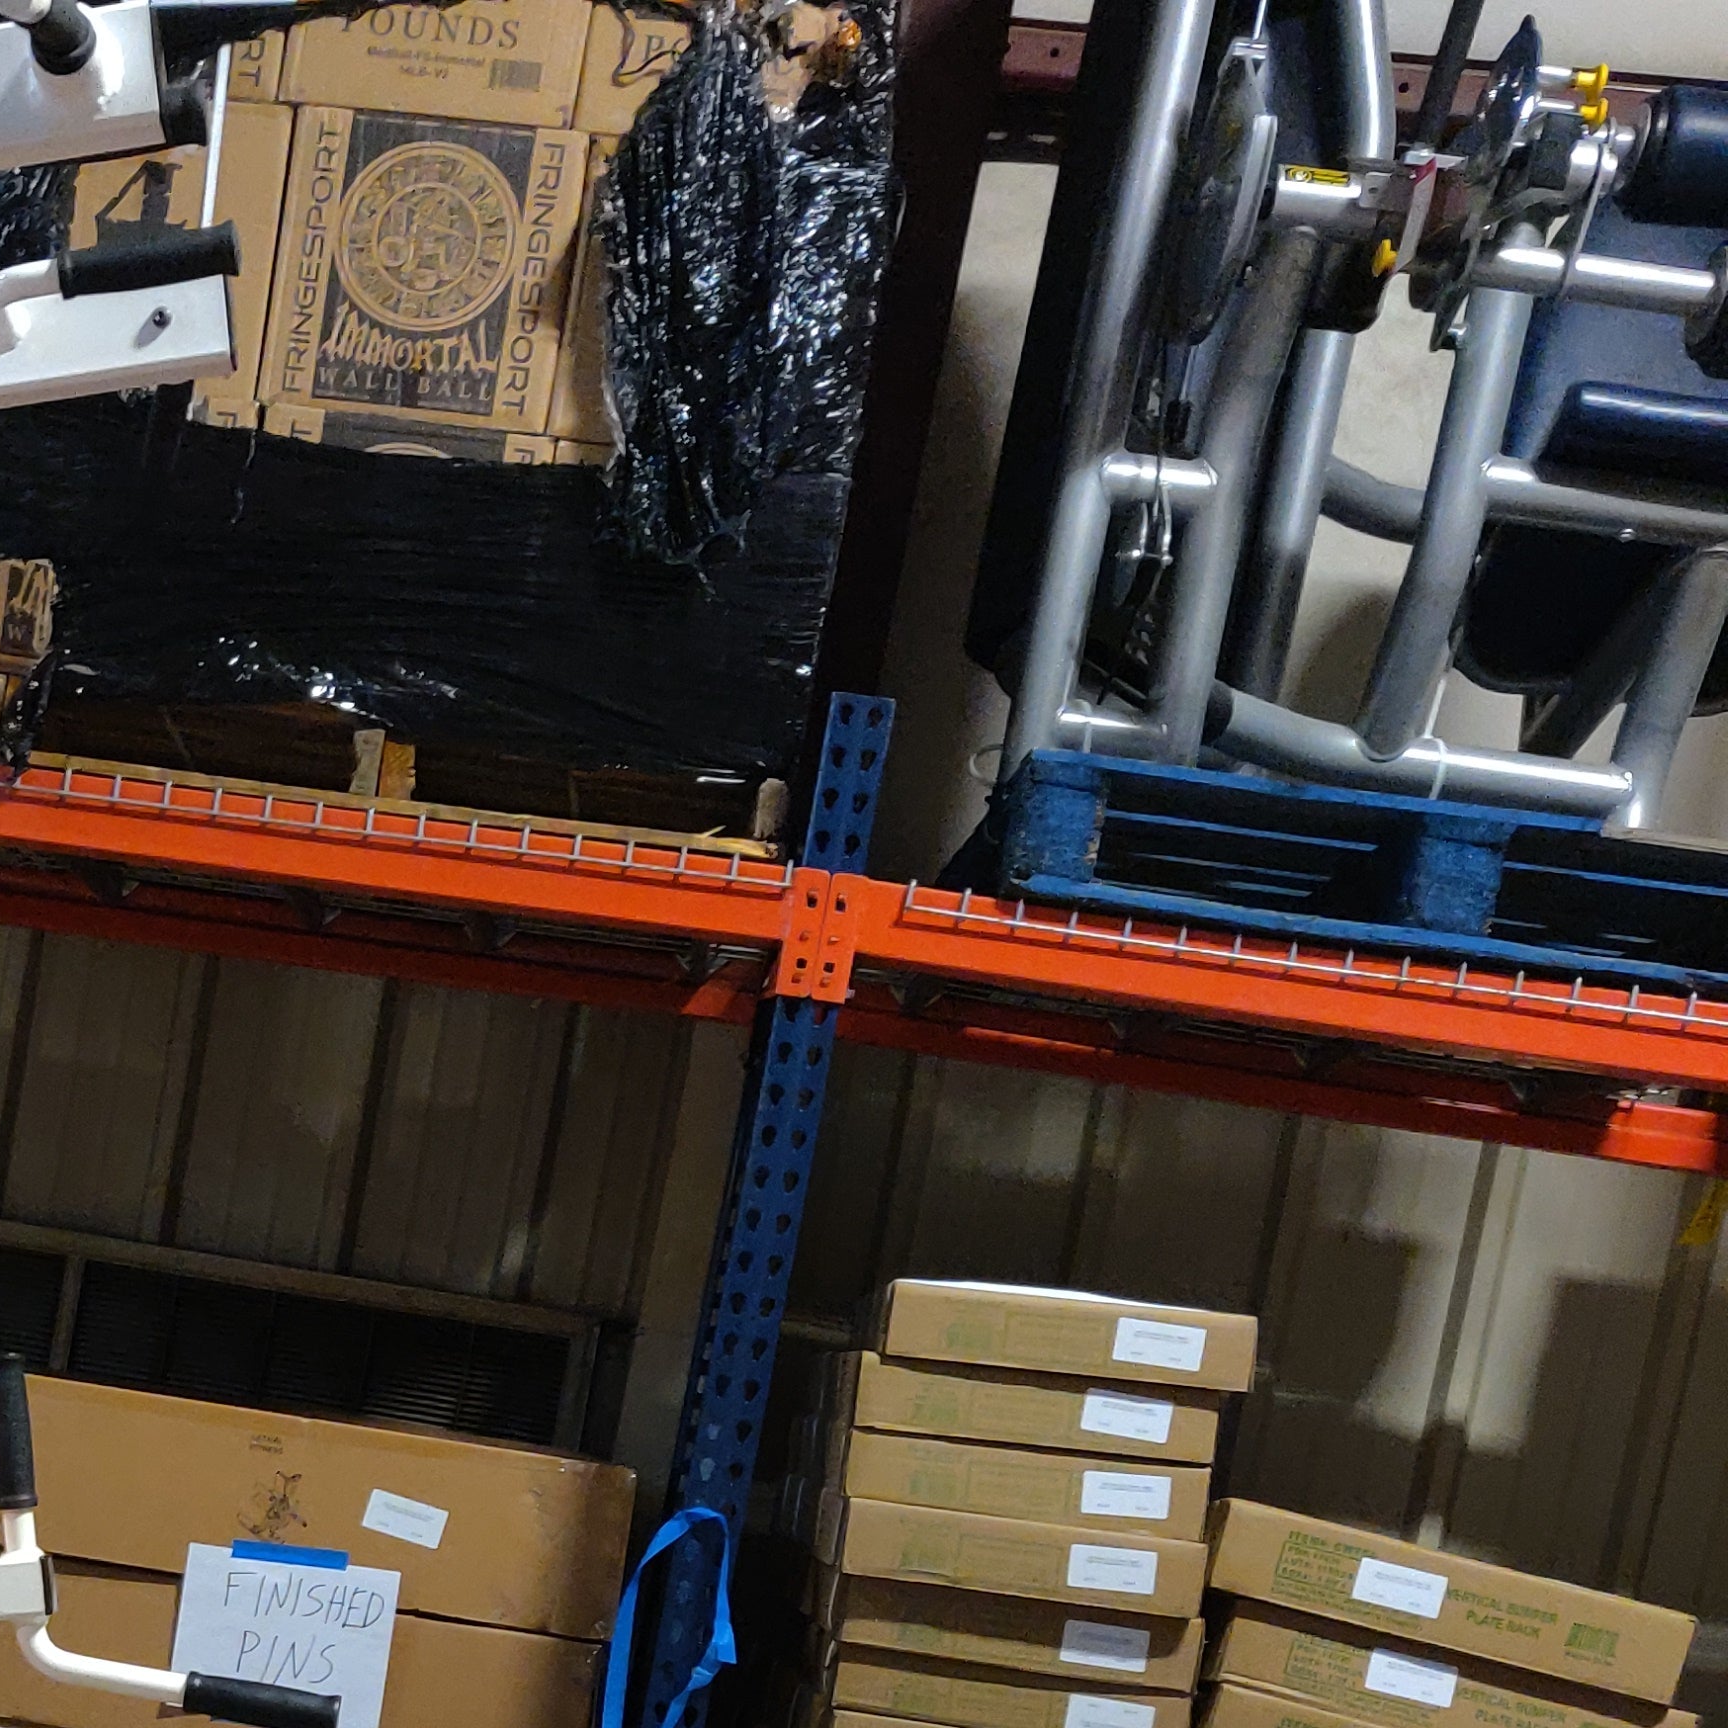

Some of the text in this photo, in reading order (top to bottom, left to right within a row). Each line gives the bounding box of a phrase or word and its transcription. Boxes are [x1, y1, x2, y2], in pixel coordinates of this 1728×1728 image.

[282, 121, 340, 392] FRINGESPORT
[502, 142, 565, 416] FRINGESPORT
[316, 301, 501, 374] IMMORTAL
[319, 366, 492, 401] WALL BALL
[224, 1571, 384, 1629] FINISHED
[1465, 1609, 1504, 1630] PLATE
[236, 1630, 336, 1685] PINS
